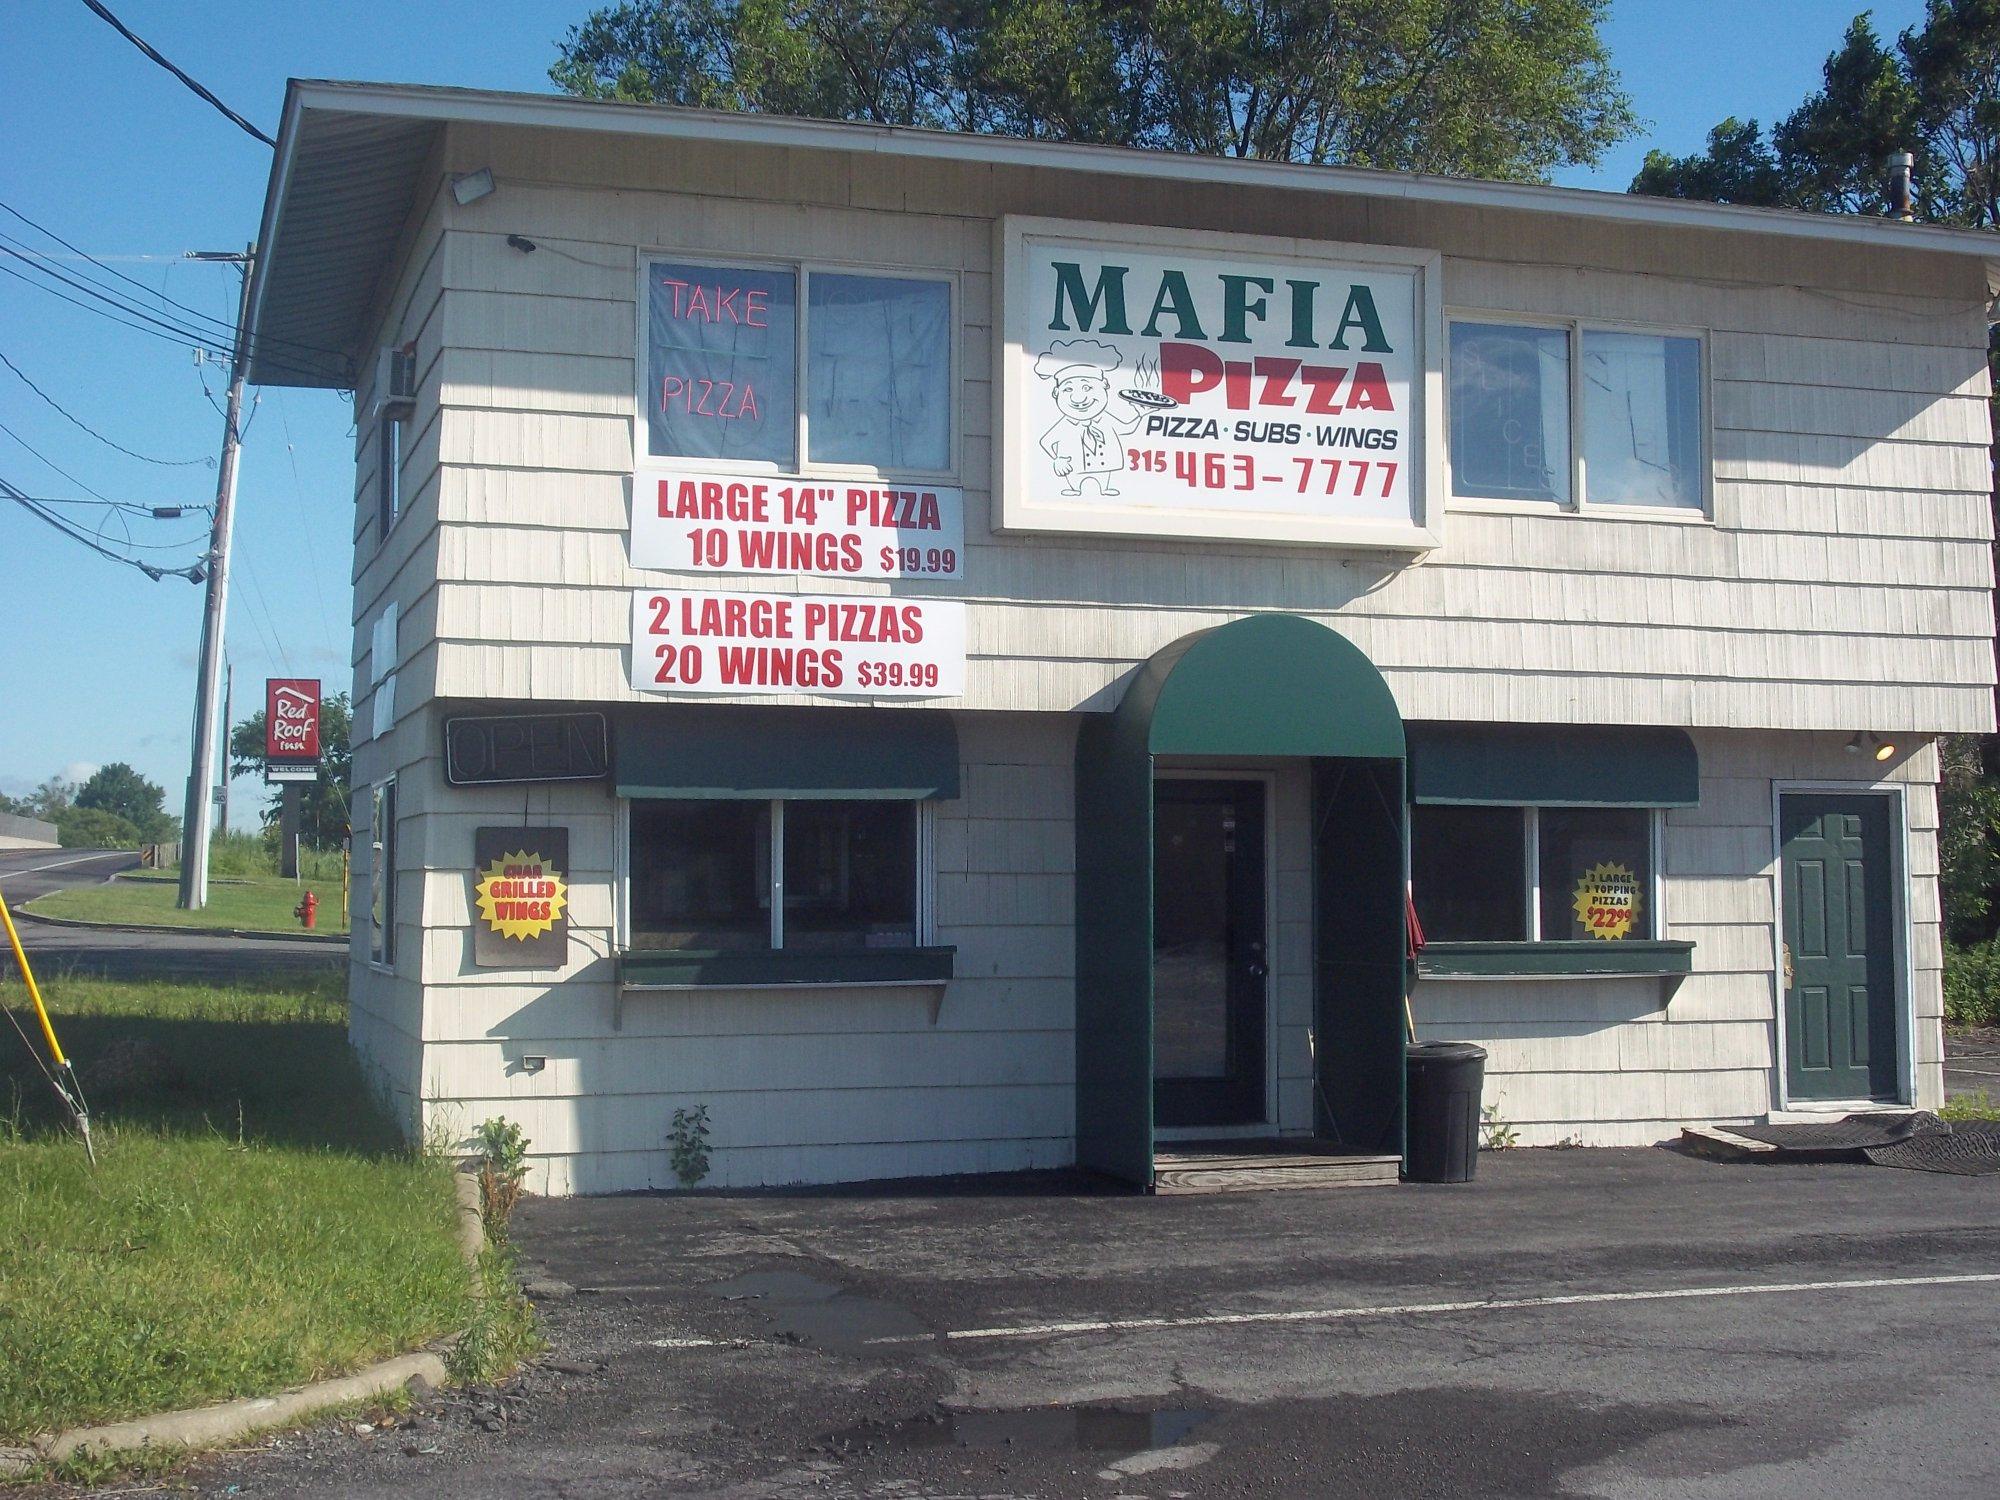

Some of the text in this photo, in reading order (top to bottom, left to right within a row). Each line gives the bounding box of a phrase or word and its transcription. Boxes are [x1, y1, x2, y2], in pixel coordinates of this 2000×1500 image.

[663, 281, 768, 328] TAKE
[1048, 262, 1393, 354] MAFIA
[1160, 342, 1394, 416] PIZZA
[662, 377, 758, 421] PIZZA
[1146, 415, 1398, 451] PIZZA SUBS WINGS
[1127, 448, 1167, 472] 315
[657, 480, 941, 531] LARGE 14" PIZZA
[686, 528, 956, 573] 10 WINGS $19.99
[648, 596, 923, 644] 2 LARGE PIZZAS
[654, 644, 938, 688] 20 WINGS $39.99
[277, 699, 308, 719] Red
[274, 718, 315, 742] Roof
[453, 719, 600, 776] OPEN
[490, 881, 556, 898] GRILLED
[503, 864, 543, 879] CHAR
[1594, 885, 1636, 894] TOPPING
[1600, 874, 1632, 883] LARGE
[495, 901, 551, 920] WINGS
[1592, 896, 1629, 905] PIZZAS
